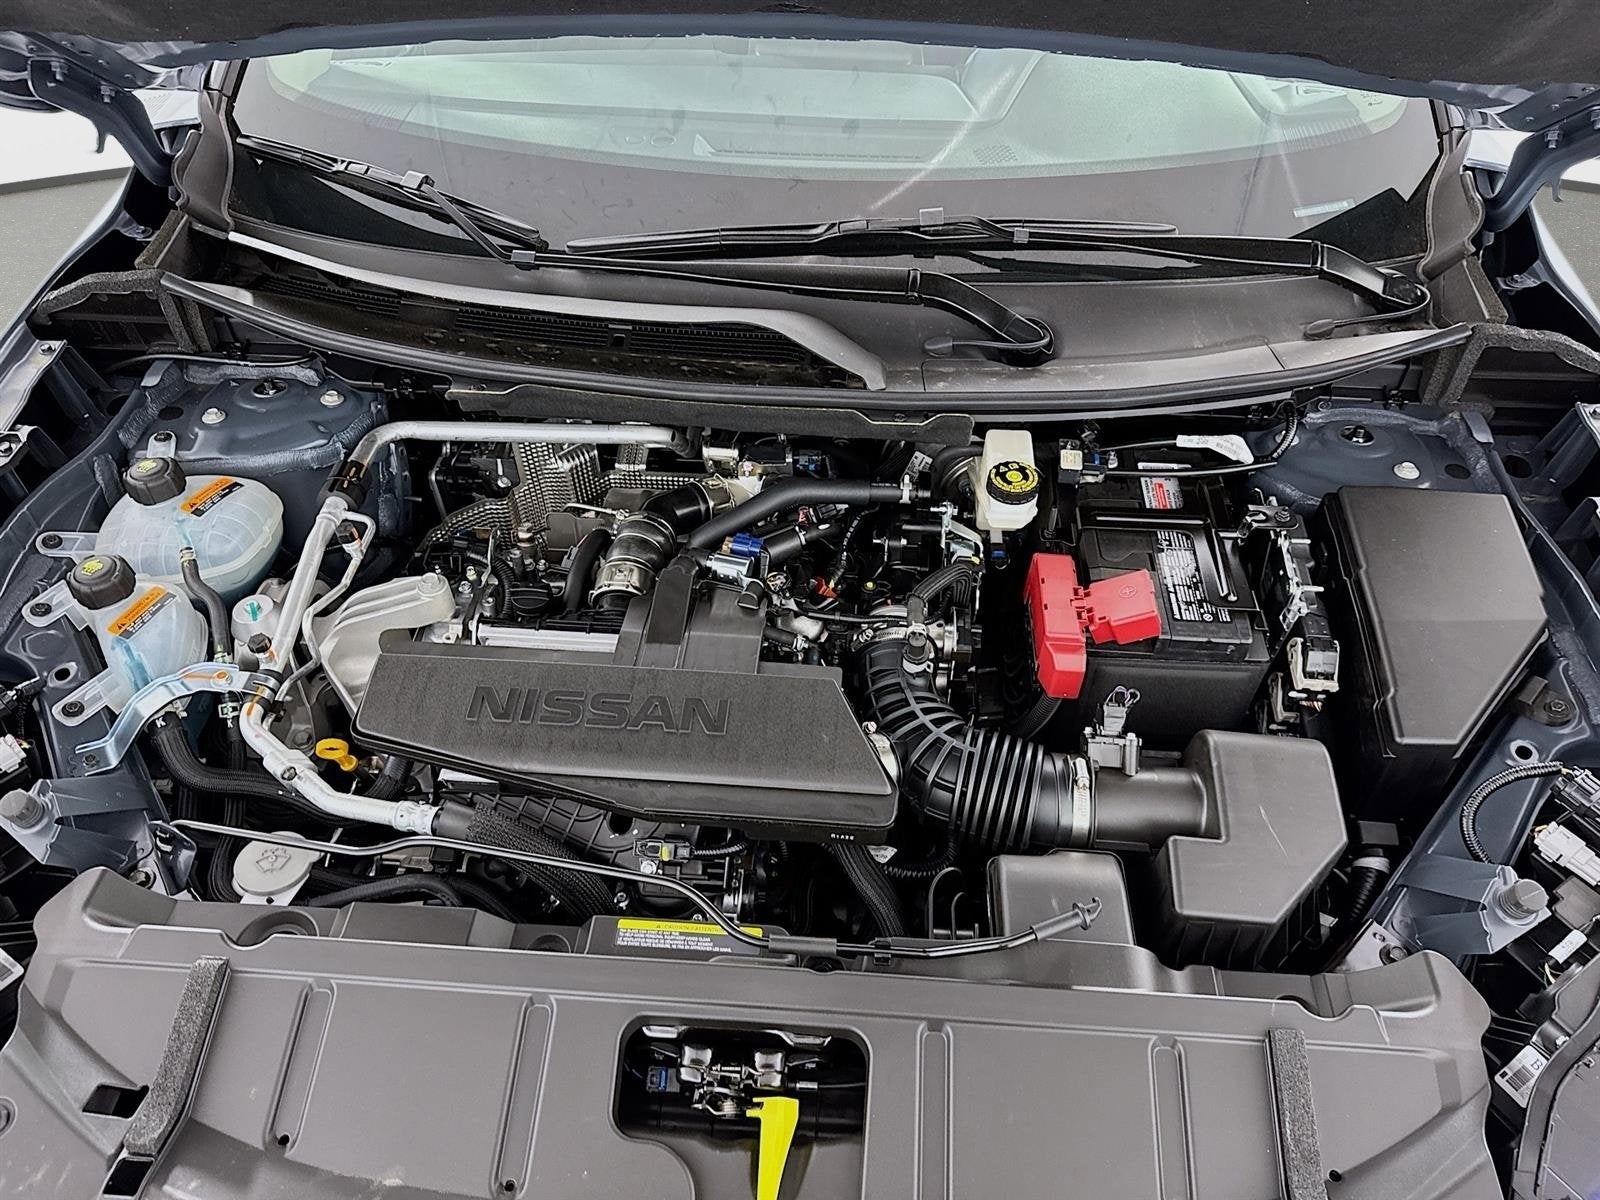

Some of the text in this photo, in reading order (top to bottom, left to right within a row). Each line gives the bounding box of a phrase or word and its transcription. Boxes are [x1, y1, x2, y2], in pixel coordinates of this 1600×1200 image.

[465, 685, 730, 735] NISSAN
[155, 716, 166, 728] K
[226, 719, 234, 729] K
